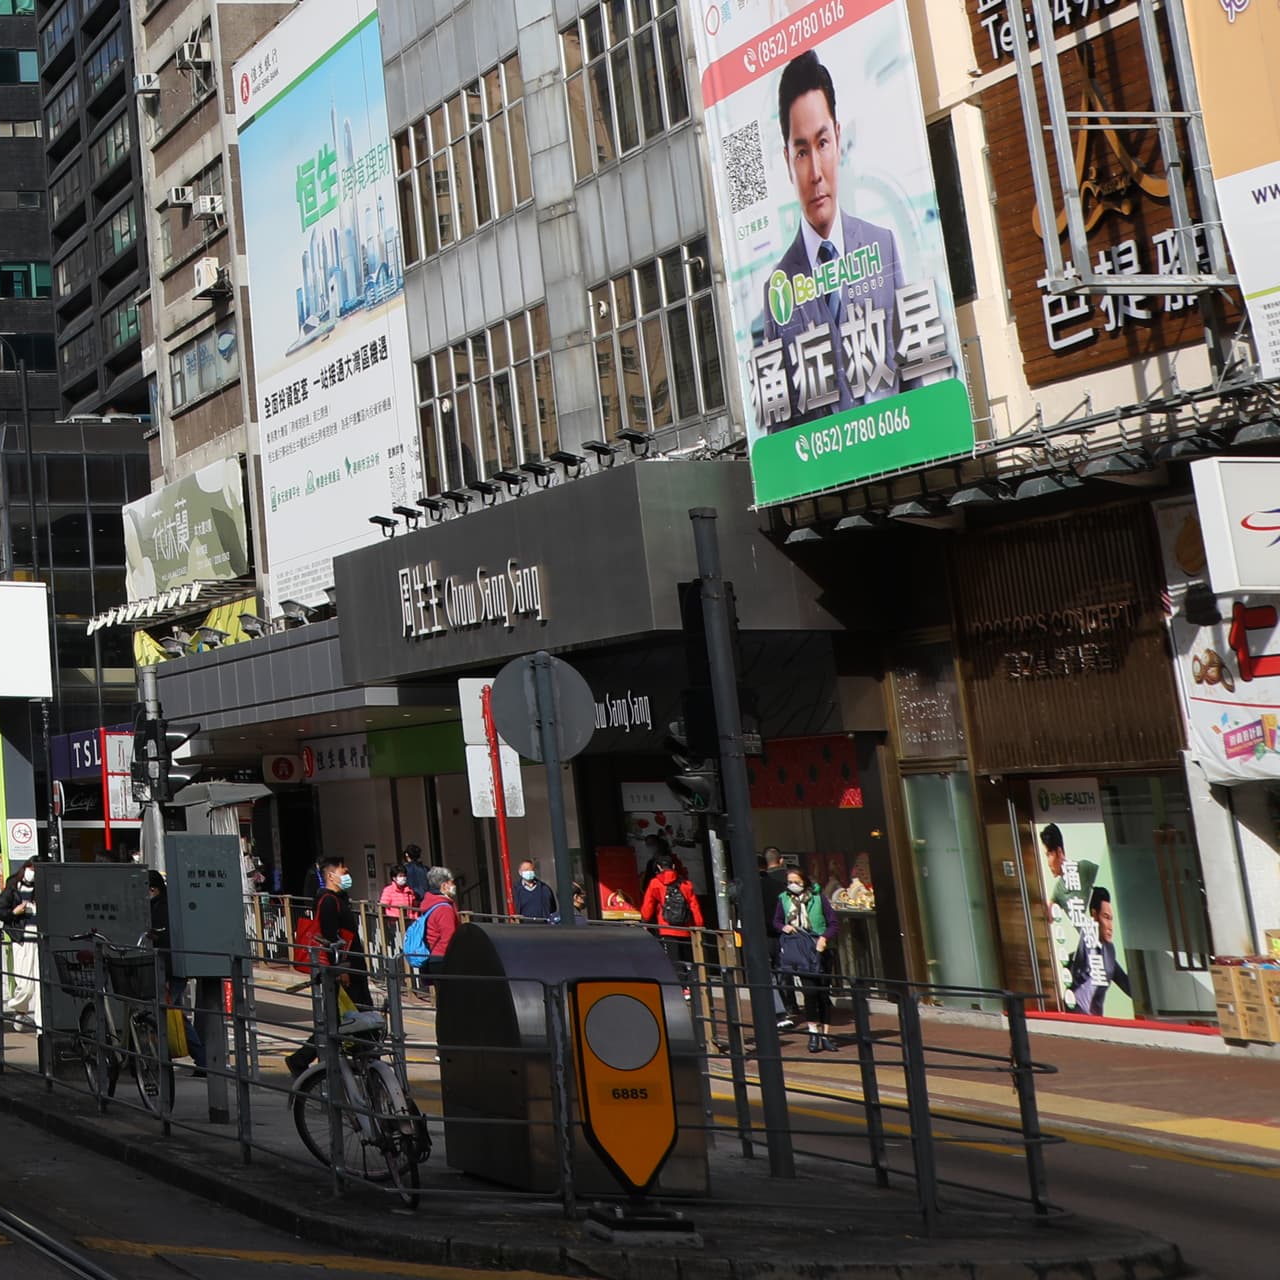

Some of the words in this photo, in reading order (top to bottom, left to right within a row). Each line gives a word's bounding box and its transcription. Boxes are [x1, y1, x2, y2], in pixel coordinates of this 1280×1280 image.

[757, 28, 788, 68] (852)
[787, 12, 819, 52] 2780
[296, 142, 338, 233] 恒生
[748, 277, 954, 427] 痛症救星
[810, 424, 843, 460] (852)
[844, 414, 877, 447] 2780
[878, 405, 910, 437] 6066
[444, 576, 477, 627] Chow
[476, 566, 510, 627] Sang
[508, 558, 543, 621] Sang
[606, 691, 630, 733] Sang
[628, 688, 653, 731] Sang
[72, 736, 102, 770] TSL
[1061, 860, 1109, 987] 痛症救星
[611, 1087, 649, 1101] 6885
